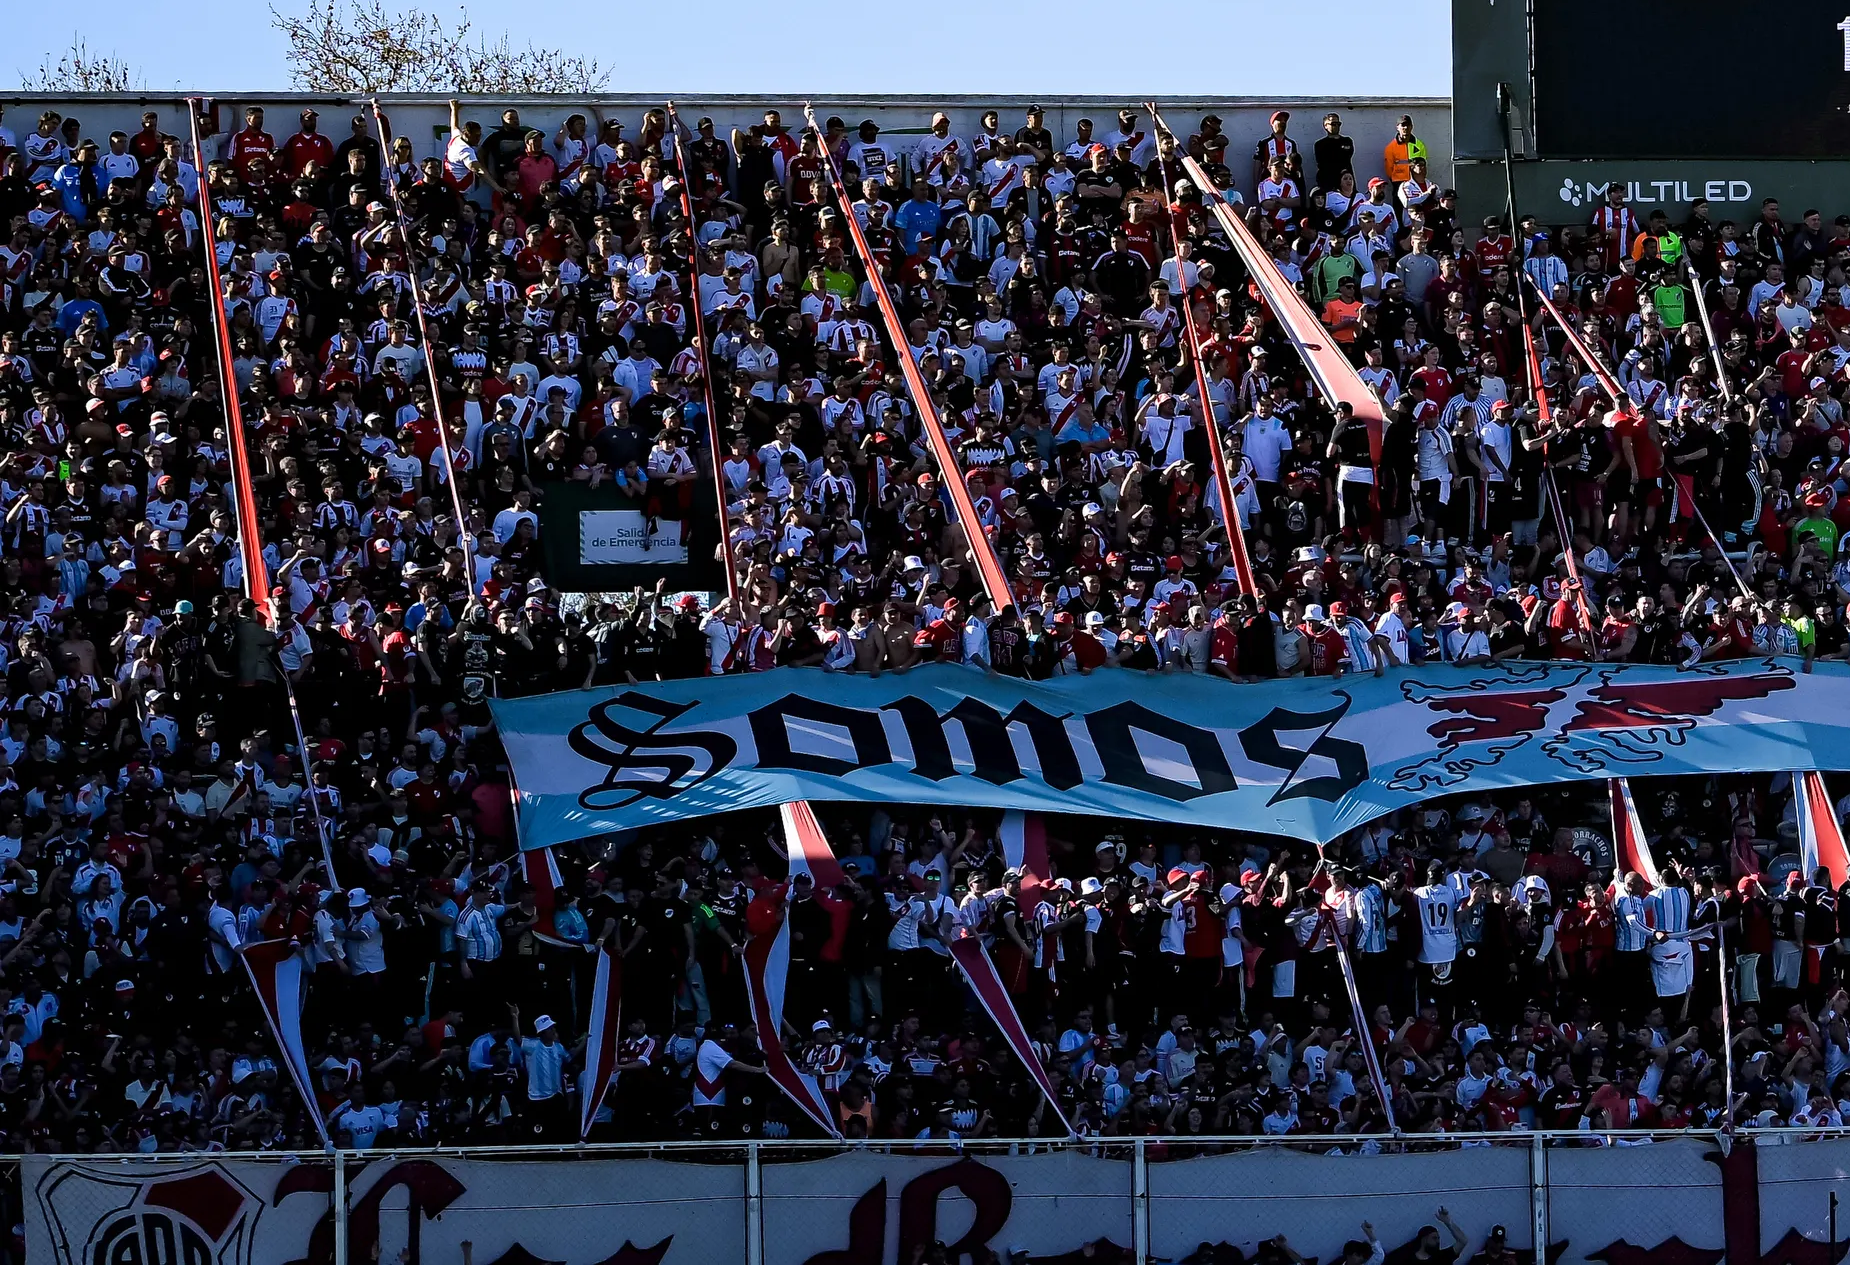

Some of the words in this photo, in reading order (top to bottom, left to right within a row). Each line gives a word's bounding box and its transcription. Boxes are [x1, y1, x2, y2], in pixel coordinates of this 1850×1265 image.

[617, 528, 648, 538] Salid
[592, 537, 606, 547] de
[566, 688, 1371, 810] Somos
[1573, 831, 1609, 857] ORRACHOS
[1427, 902, 1448, 927] 19
[354, 1127, 373, 1135] VISA
